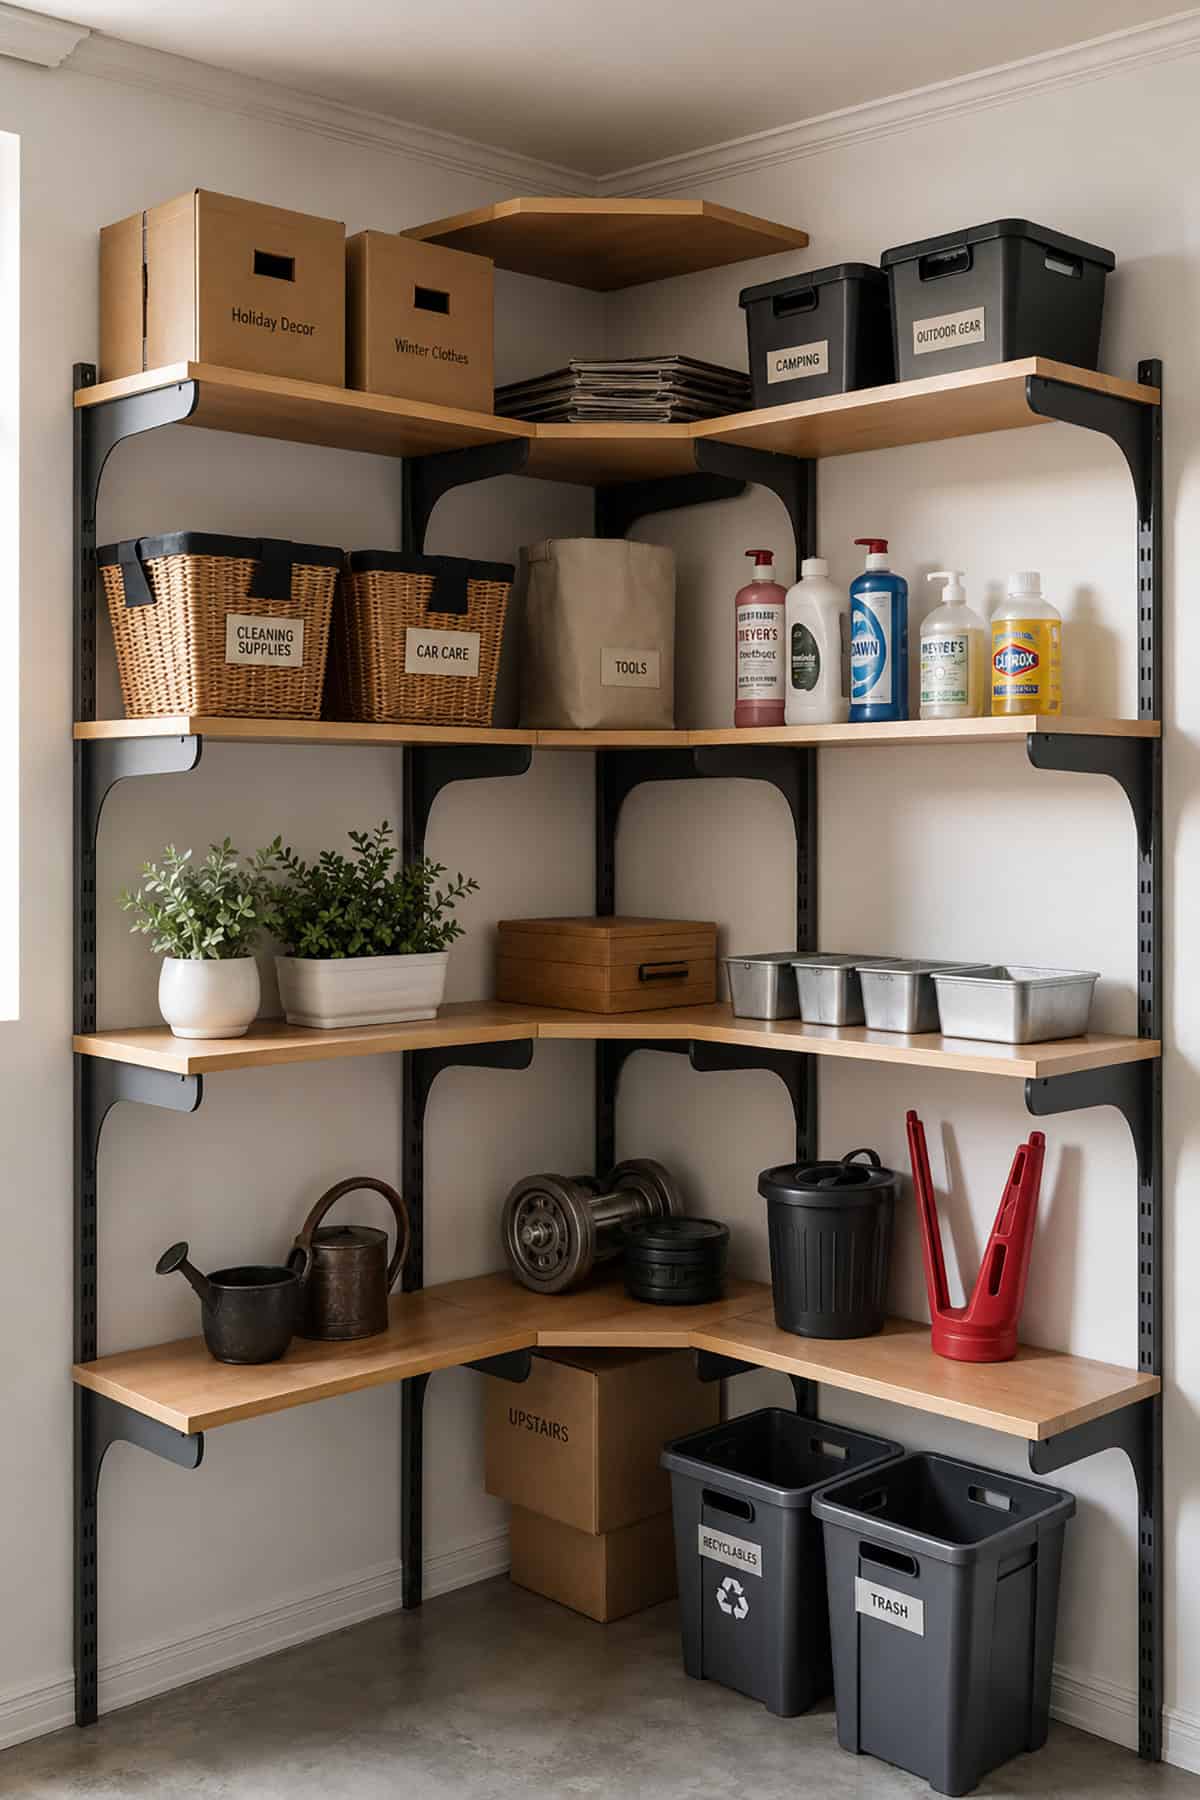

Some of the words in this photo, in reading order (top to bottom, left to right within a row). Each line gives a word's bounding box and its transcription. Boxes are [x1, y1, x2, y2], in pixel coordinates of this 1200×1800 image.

[232, 307, 278, 332] Holiday
[281, 316, 316, 336] Decor
[917, 324, 957, 343] OUTDOOR
[958, 319, 981, 335] GEAR
[394, 338, 430, 358] Winter
[431, 345, 469, 365] Clothes
[776, 353, 820, 372] CAMPING
[236, 626, 294, 642] CLEANING
[238, 641, 292, 657] SUPPLIES
[416, 644, 439, 659] CAR
[441, 645, 470, 661] CARE
[852, 641, 880, 656] DAWN
[615, 660, 648, 674] TOOLS
[508, 1407, 569, 1443] UPSTAIRS
[703, 1535, 758, 1566] RECYCLABLES
[870, 1592, 909, 1619] TRASH
